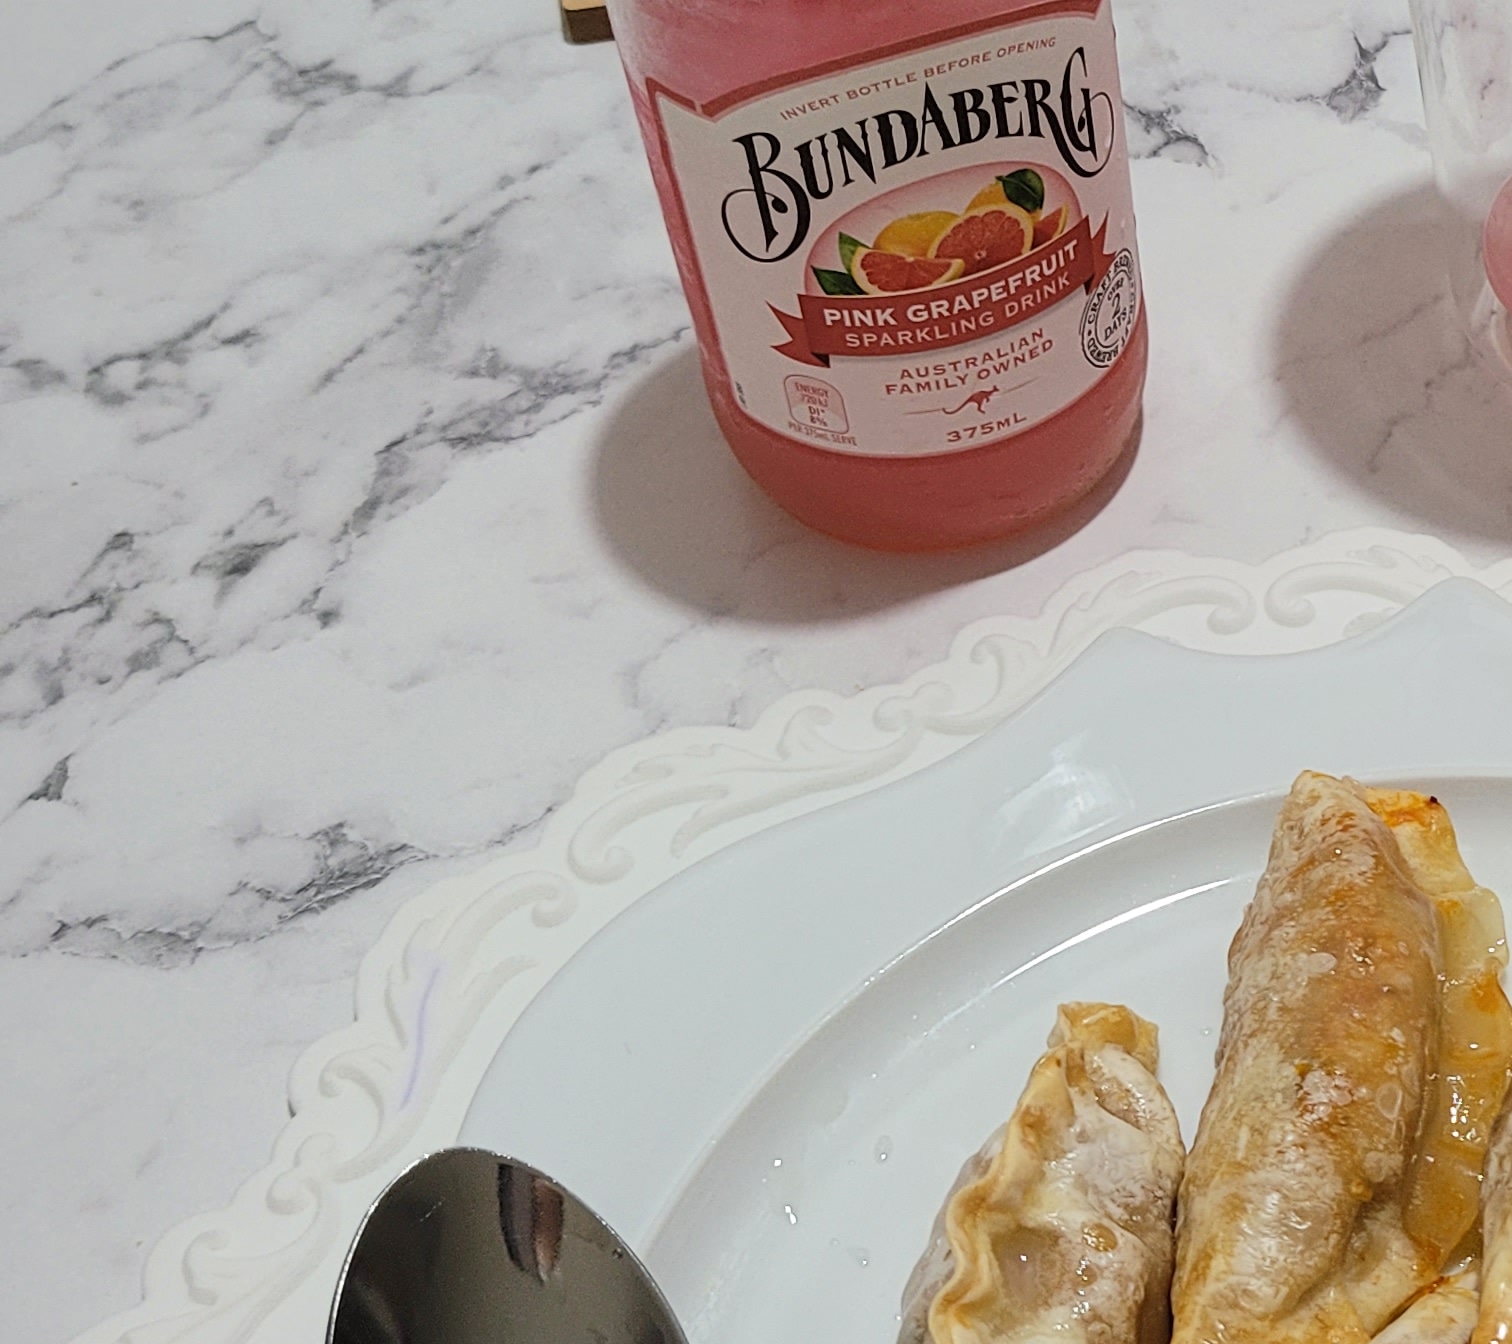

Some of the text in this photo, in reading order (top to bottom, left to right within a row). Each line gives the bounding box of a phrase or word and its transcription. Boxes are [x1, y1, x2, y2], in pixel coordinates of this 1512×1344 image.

[780, 37, 1056, 121] INVERT BOTTLE BEFORE OPENING
[721, 47, 1115, 263] BUNDABERG
[823, 240, 1079, 327] PINK GRAPEFRUIT
[845, 271, 1071, 348] SPARKLING DRINK
[885, 339, 1054, 396] FAMILY OWNED
[900, 328, 1045, 380] AUSTRALIAN
